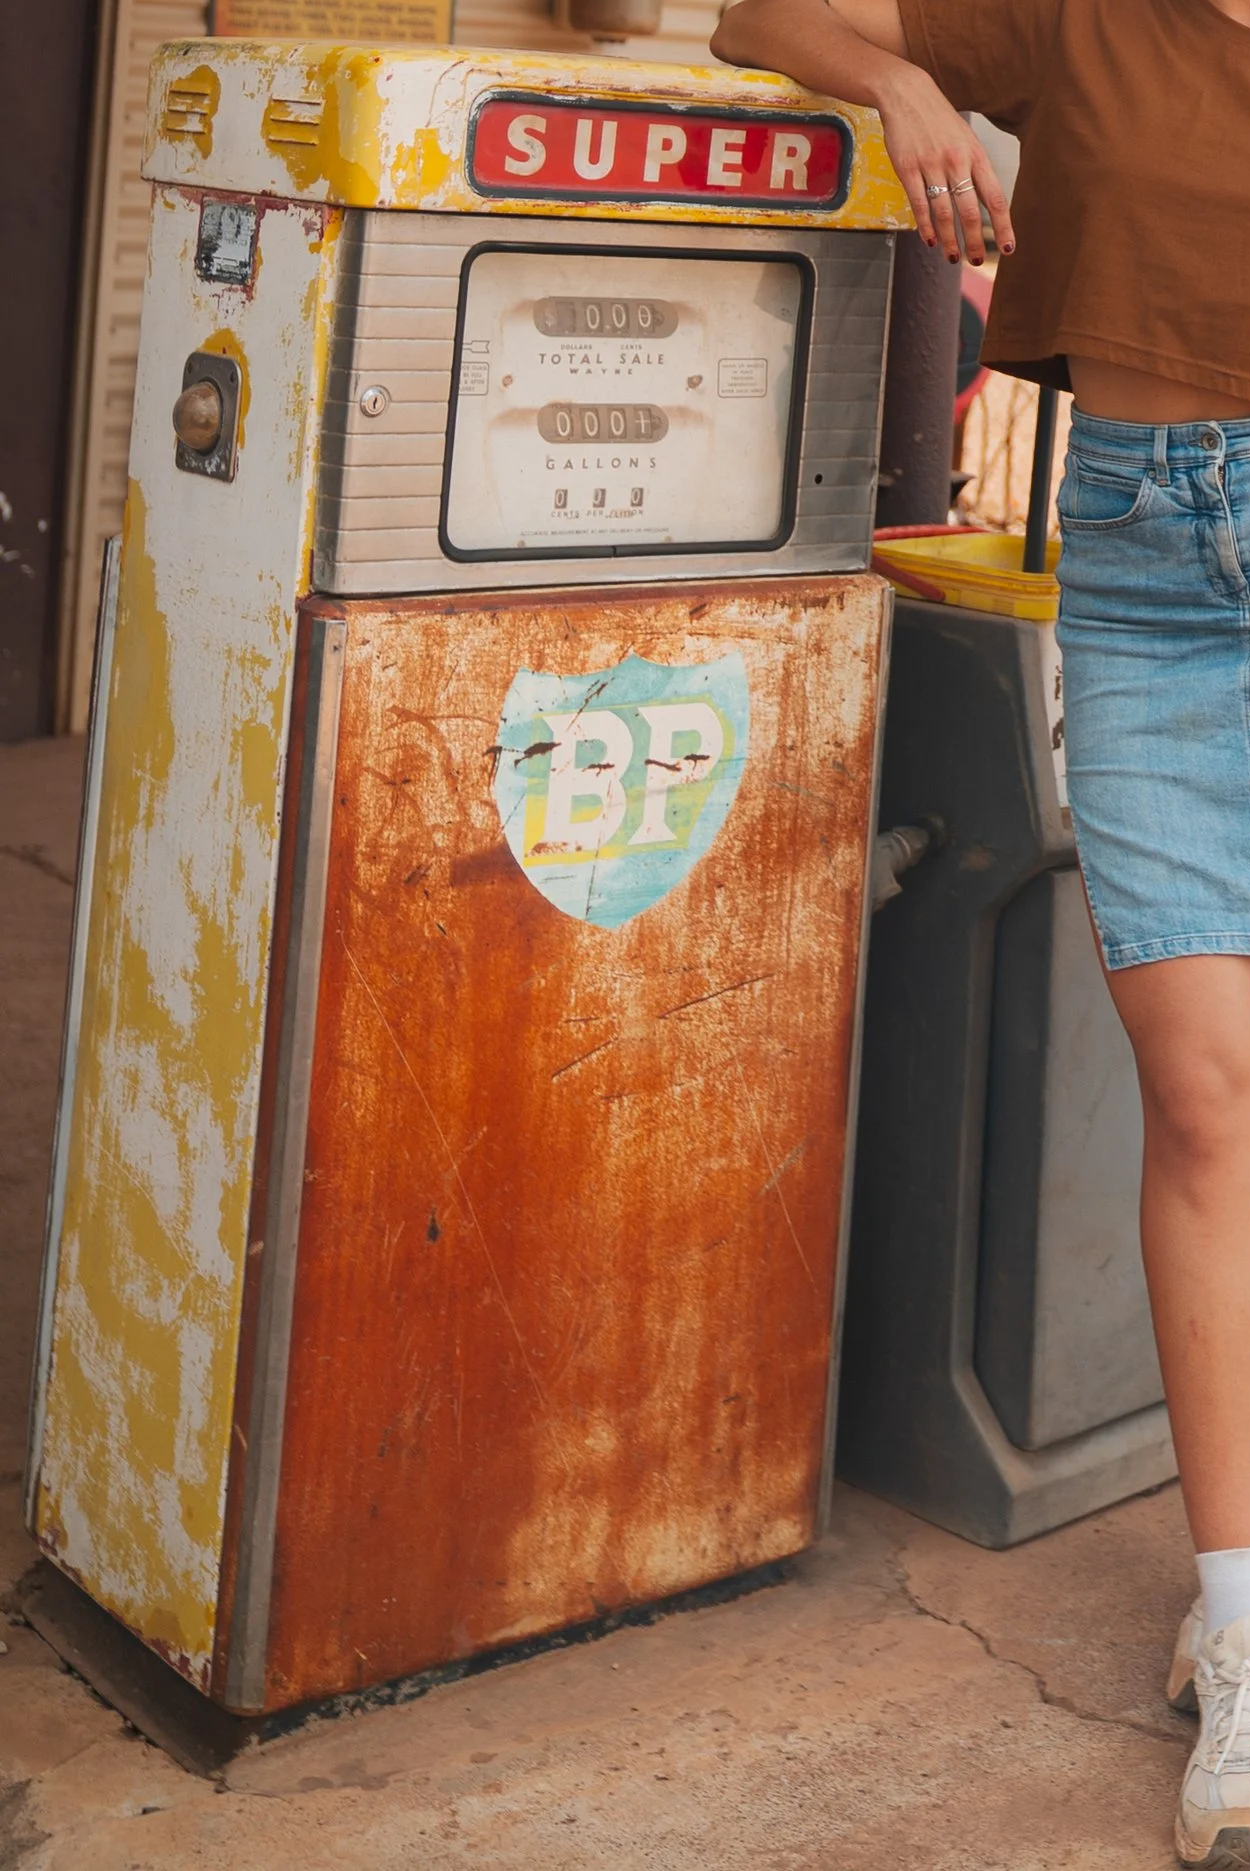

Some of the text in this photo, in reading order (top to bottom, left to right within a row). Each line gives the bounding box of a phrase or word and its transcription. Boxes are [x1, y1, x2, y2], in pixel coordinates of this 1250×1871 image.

[504, 115, 812, 191] SUPER
[538, 353, 665, 365] TOTAL SALE
[546, 457, 657, 470] GALLONS
[528, 702, 724, 854] BP
